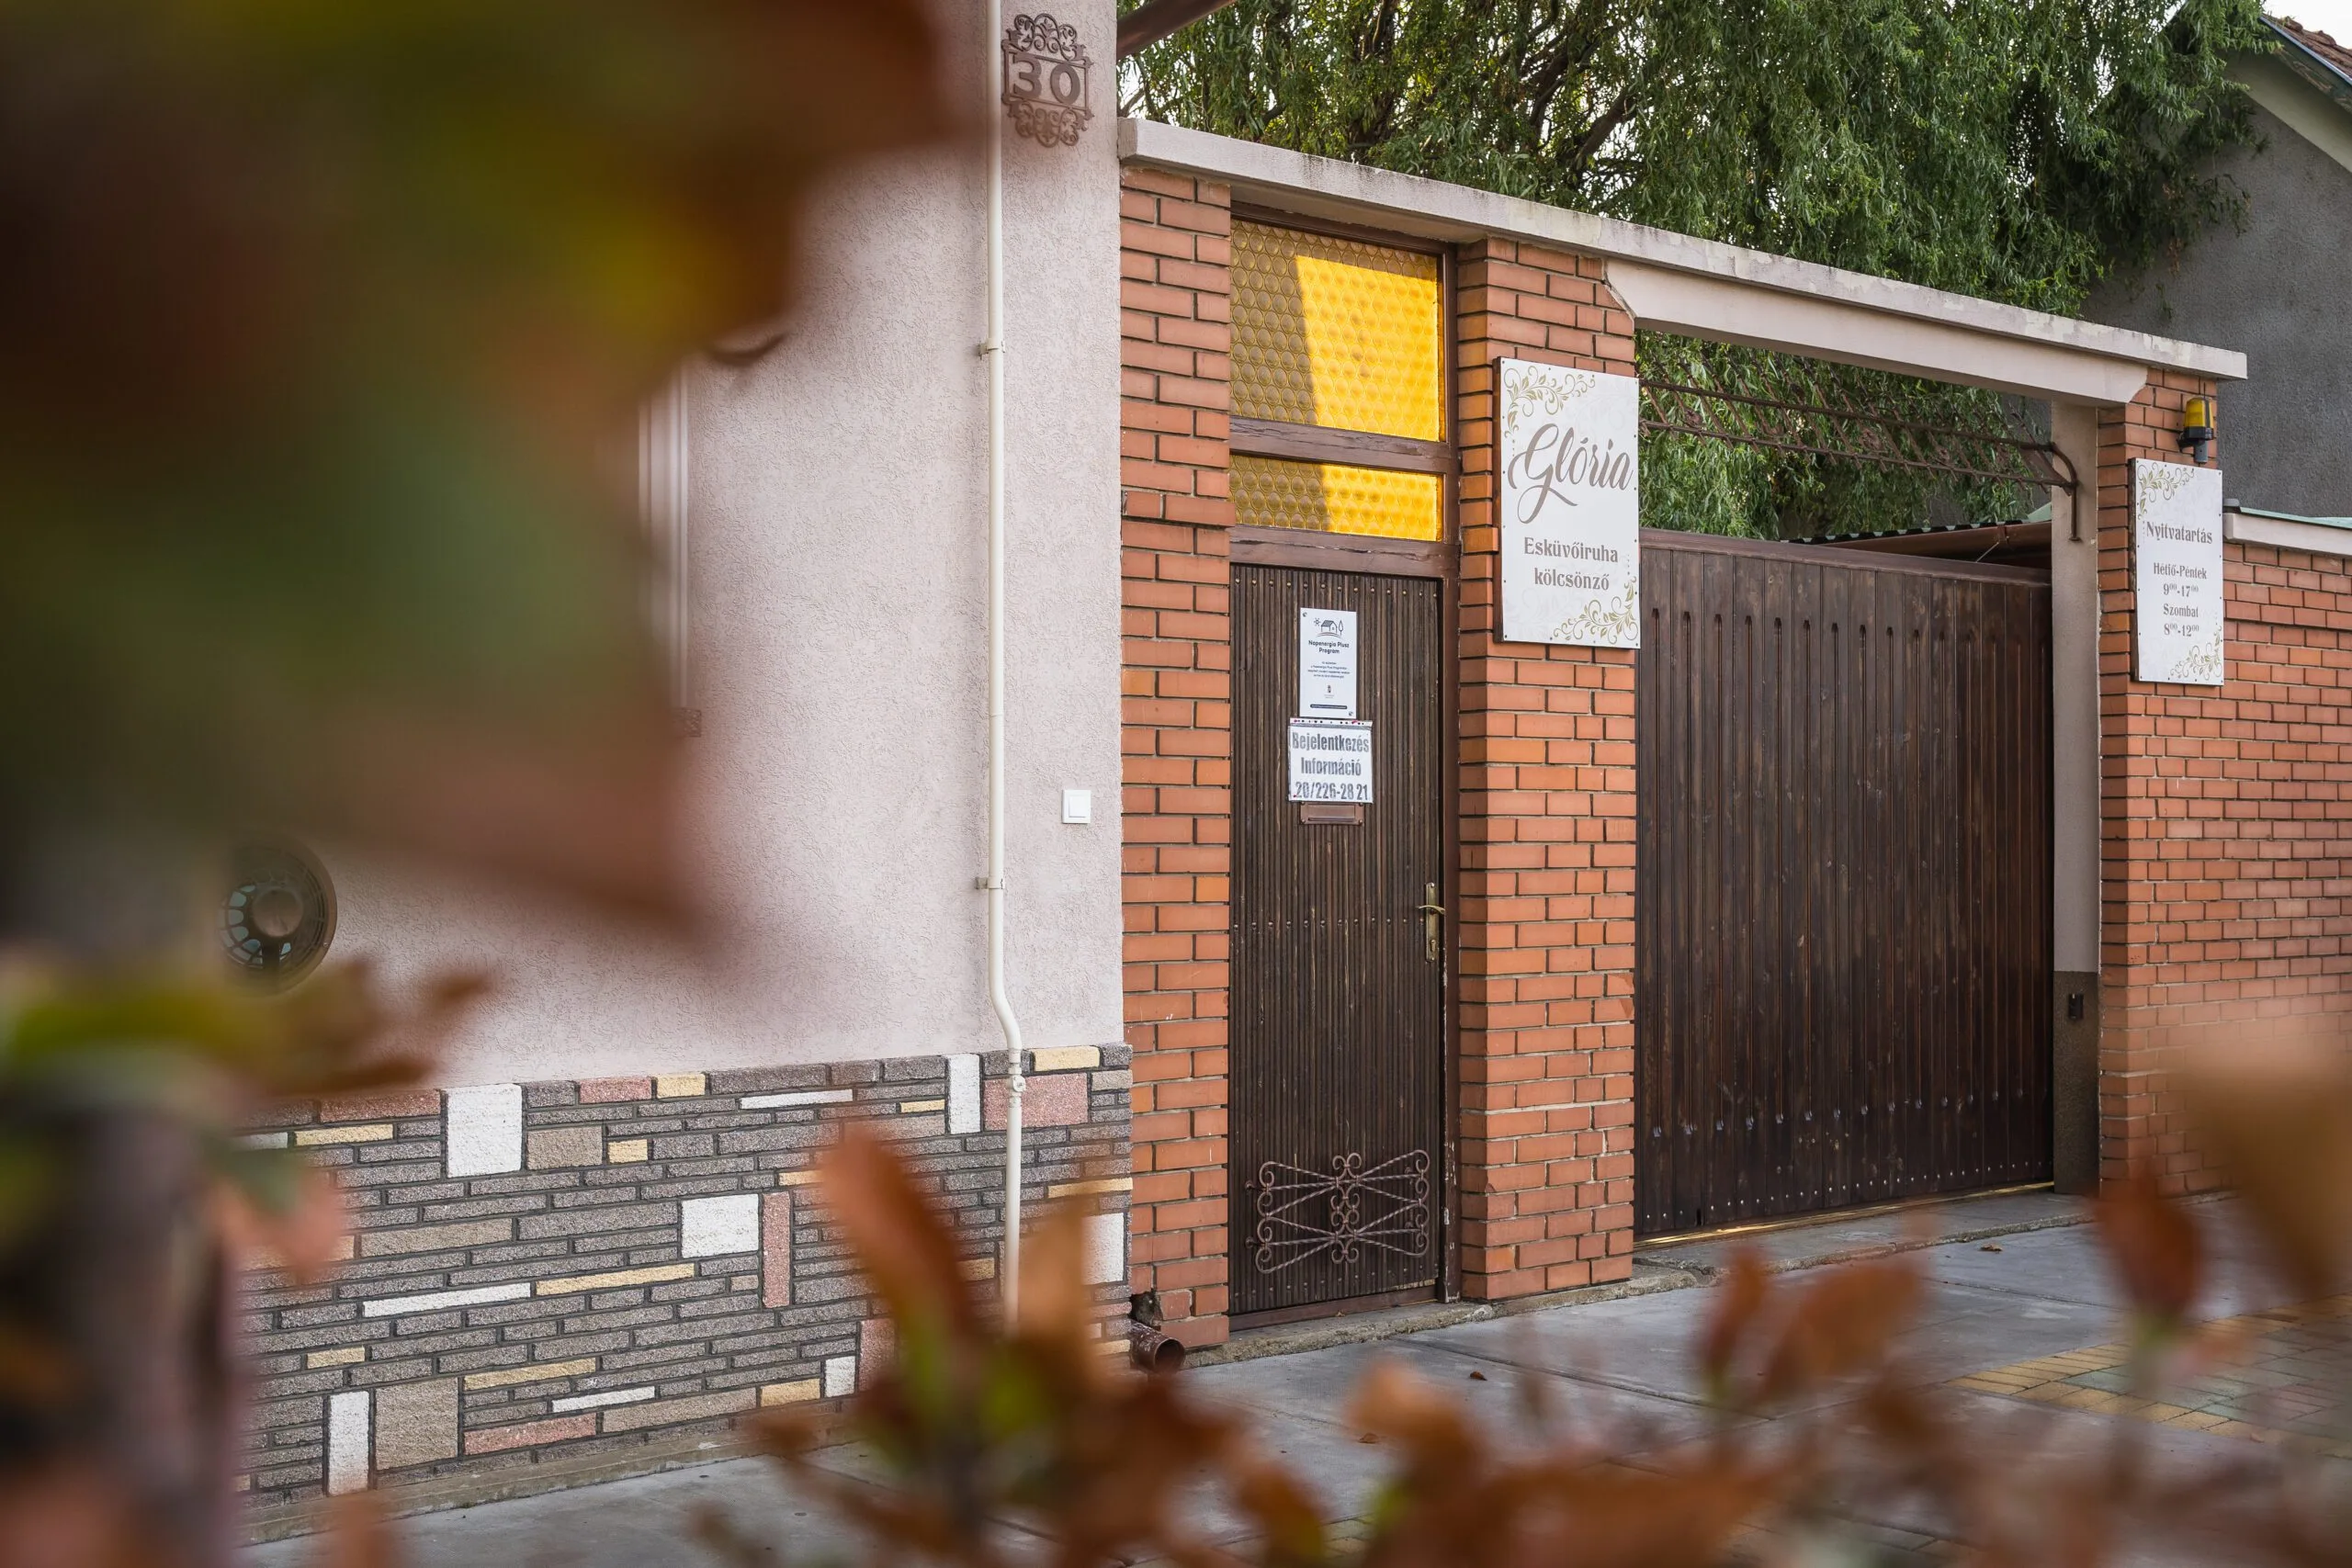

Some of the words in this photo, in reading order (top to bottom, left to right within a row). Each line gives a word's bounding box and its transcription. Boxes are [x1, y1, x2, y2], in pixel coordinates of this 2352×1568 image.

[1012, 52, 1081, 105] 30
[1507, 423, 1634, 525] Glória
[2146, 521, 2213, 545] Nyitvatartás
[1524, 536, 1619, 563] Esküvőiruha
[1533, 567, 1610, 591] kölcsönző
[2163, 603, 2199, 618] Szombat
[1318, 647, 1340, 655] Program
[1292, 731, 1370, 753] Bejelentkezés
[1301, 757, 1362, 776] Információ
